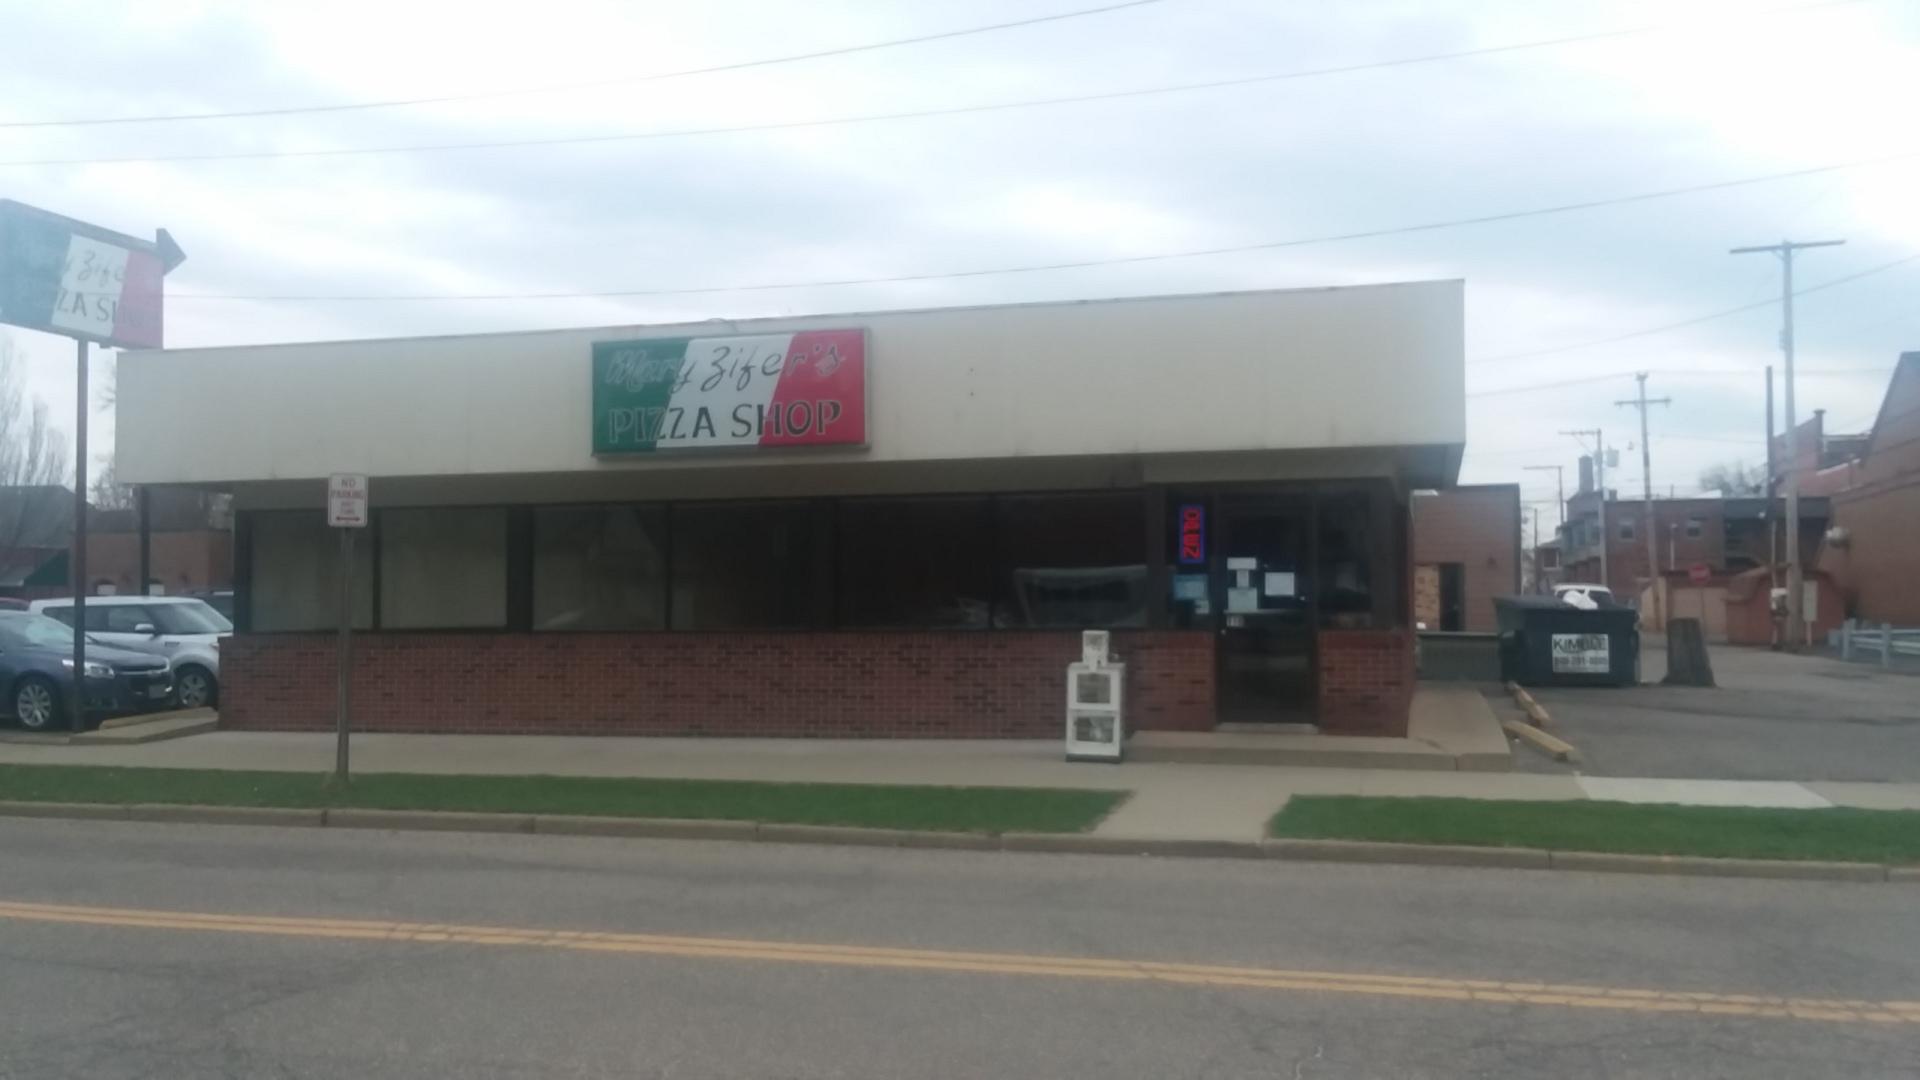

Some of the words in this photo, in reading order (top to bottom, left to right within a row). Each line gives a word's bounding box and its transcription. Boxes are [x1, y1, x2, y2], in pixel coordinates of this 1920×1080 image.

[605, 348, 697, 393] Mary
[700, 345, 846, 393] Zifer's
[608, 404, 716, 443] PIZZA
[731, 400, 841, 439] SHOP
[341, 479, 357, 489] NO
